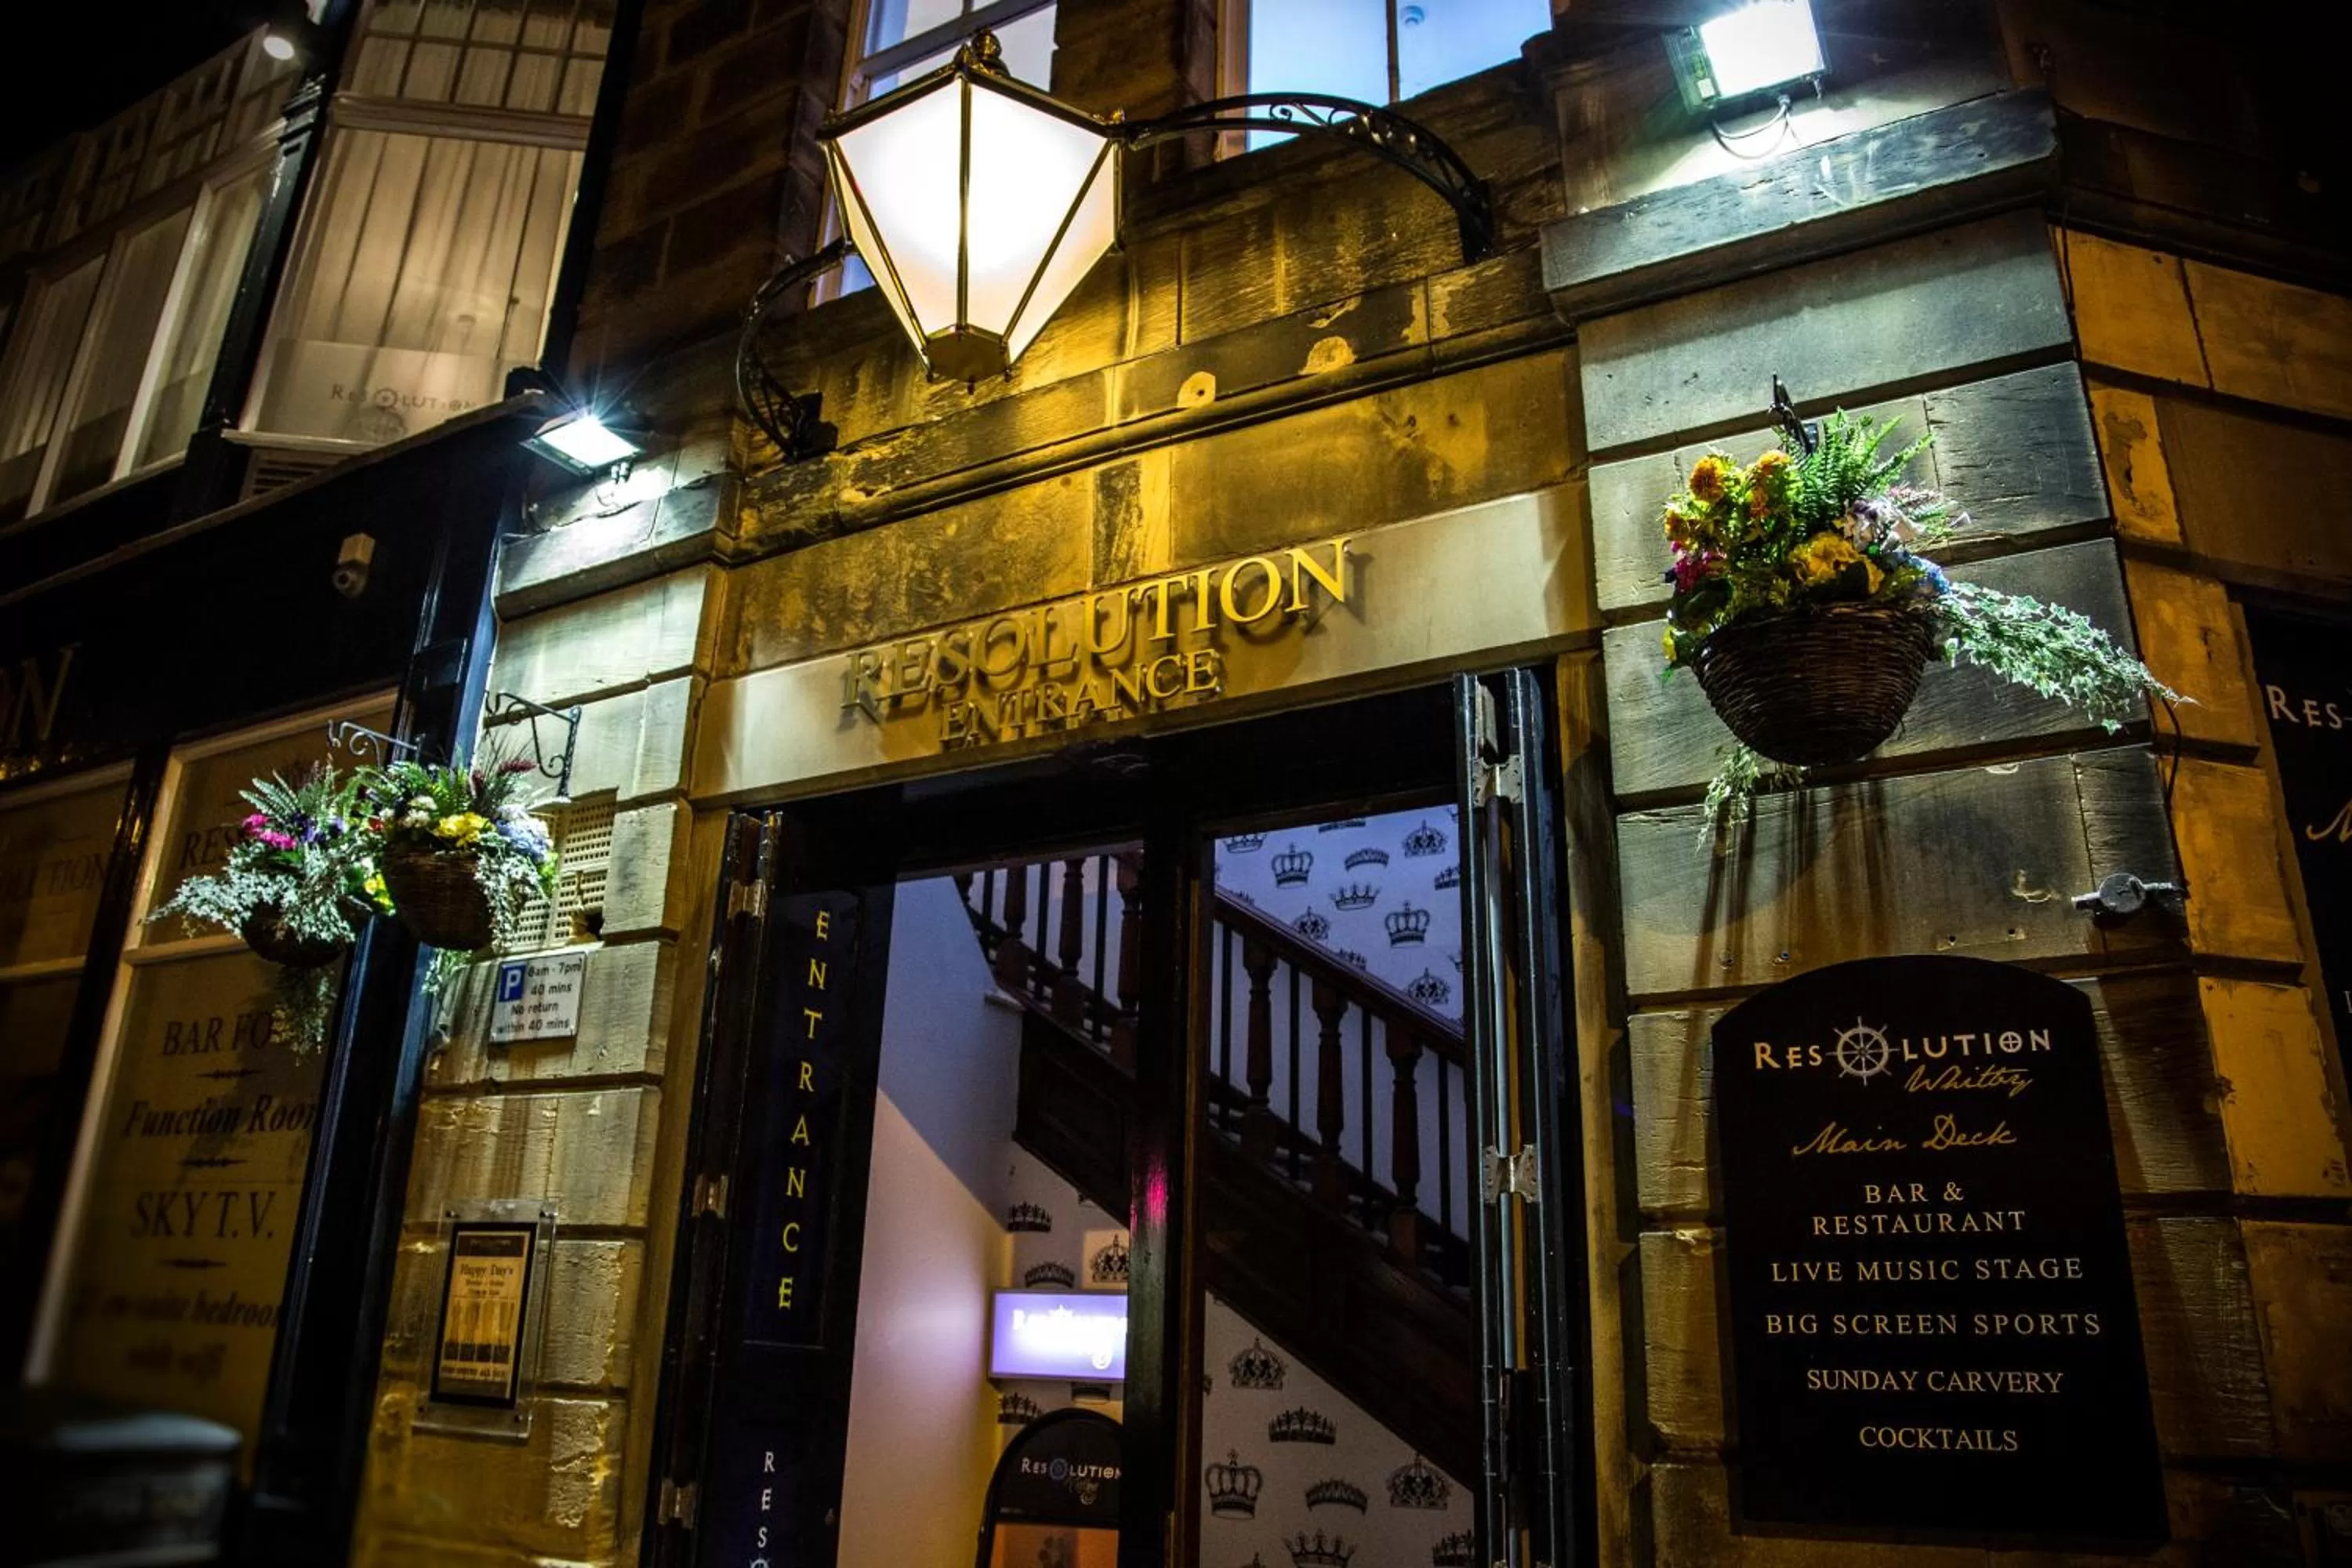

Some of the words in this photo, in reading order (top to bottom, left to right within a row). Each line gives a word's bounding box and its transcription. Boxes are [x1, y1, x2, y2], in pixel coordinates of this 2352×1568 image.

[841, 539, 1353, 711] RESOLUTION
[941, 648, 1221, 743] ENTRANCE
[2266, 684, 2344, 731] RES
[504, 968, 522, 1000] P
[531, 984, 546, 996] 40
[548, 981, 572, 995] mins
[510, 1004, 524, 1015] No
[528, 1002, 559, 1014] return
[160, 1017, 224, 1056] BAR
[231, 1009, 273, 1051] FO
[496, 1022, 524, 1034] within
[528, 1018, 543, 1031] 40
[546, 1018, 570, 1029] mins
[1754, 1017, 2051, 1086] RESOLUTION
[1904, 1063, 2033, 1097] Whitby
[122, 1095, 244, 1138] Function
[779, 909, 830, 1311] ENTRANCE
[1792, 1121, 1907, 1156] Main
[1921, 1113, 2017, 1151] Deck
[1864, 1182, 1929, 1204] BAR
[1943, 1181, 1965, 1202] &
[130, 1190, 207, 1240] SKY
[215, 1190, 277, 1240] T.V.
[1812, 1210, 2026, 1236] RESTAURANT
[1771, 1261, 1842, 1283] LIVE
[1857, 1259, 1959, 1282] MUSIC
[1974, 1257, 2084, 1281] STAGE
[1766, 1314, 1818, 1334] BIG
[1832, 1313, 1957, 1335] SCREEN
[1973, 1312, 2101, 1336] SPORTS
[1806, 1369, 1918, 1392] SUNDAY
[1926, 1370, 2064, 1394] CARVERY
[1859, 1425, 2019, 1452] COCKTAILS
